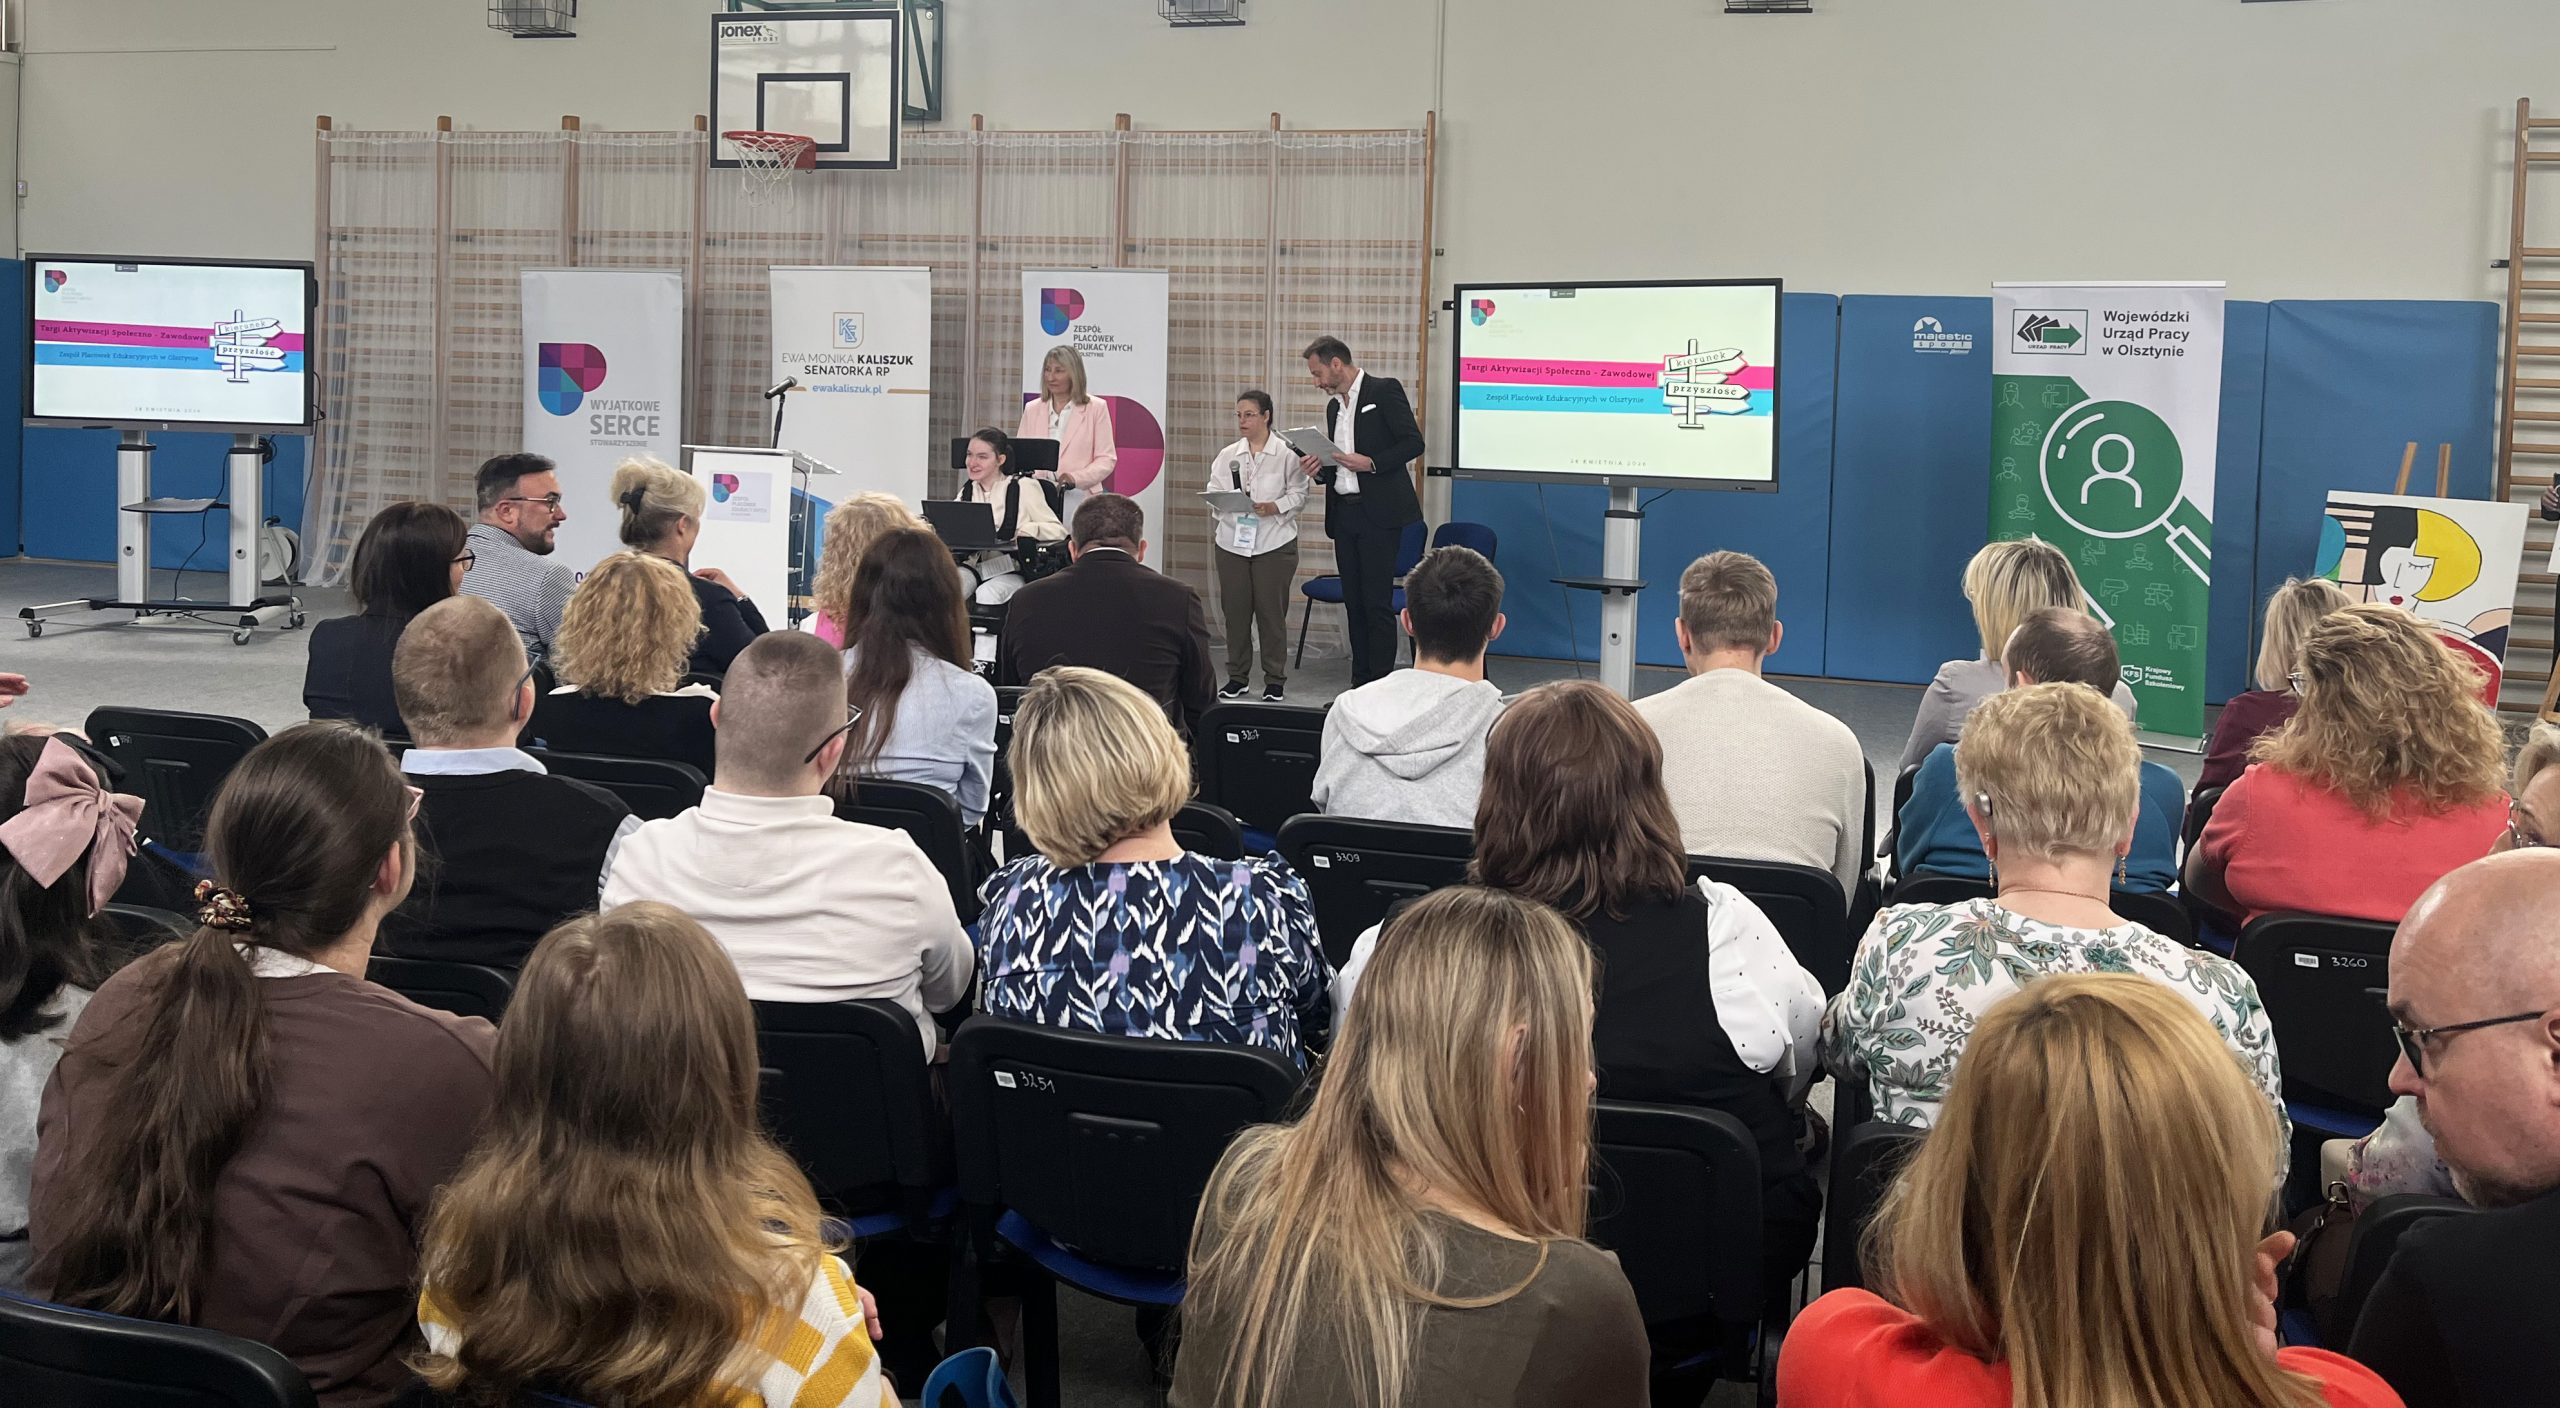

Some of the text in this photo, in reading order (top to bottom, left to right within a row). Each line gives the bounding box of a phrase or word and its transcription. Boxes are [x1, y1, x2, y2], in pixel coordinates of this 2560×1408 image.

[2103, 310, 2190, 324] Wojewódzki
[225, 321, 266, 332] kierunek
[1073, 324, 1102, 333] ZESPÓŁ
[40, 325, 61, 333] Targi
[62, 326, 110, 336] Aktywizacji
[112, 329, 152, 338] Społeczno
[160, 333, 207, 342] Zawodowej
[1073, 334, 1115, 342] PLACÓWEK
[1914, 333, 1972, 341] majestic
[2103, 327, 2190, 342] Urząd Pracy
[222, 346, 276, 356] przyszłość
[1073, 343, 1133, 352] EDUKACYJNYCH
[2102, 344, 2184, 359] w Olsztynie
[782, 353, 914, 365] EWA MONIKA KALISZUK
[1676, 352, 1726, 367] kierunek
[804, 365, 890, 376] SENATORKA RP
[1466, 363, 1488, 373] Targi
[1490, 365, 1543, 375] Aktywizacji
[1545, 367, 1591, 377] Społeczno
[1601, 369, 1655, 381] Zawodowej
[812, 384, 882, 395] ewakaliszuk.pl
[1673, 385, 1737, 396] przyszłość
[1486, 393, 1509, 403] Zespół
[1511, 394, 1543, 402] Placówek
[1546, 394, 1598, 404] Edukacyjnych
[1609, 396, 1644, 405] Olsztynie
[590, 399, 660, 413] WYJĄTKOWE
[590, 414, 660, 436] SERCE
[2145, 666, 2172, 675] Krajowy
[2145, 673, 2173, 682] Fundusz
[2144, 680, 2185, 691] Szkoleniowy
[1336, 853, 1360, 864] 3309
[2331, 956, 2368, 968] 3260
[1019, 1071, 1056, 1094] 3251
